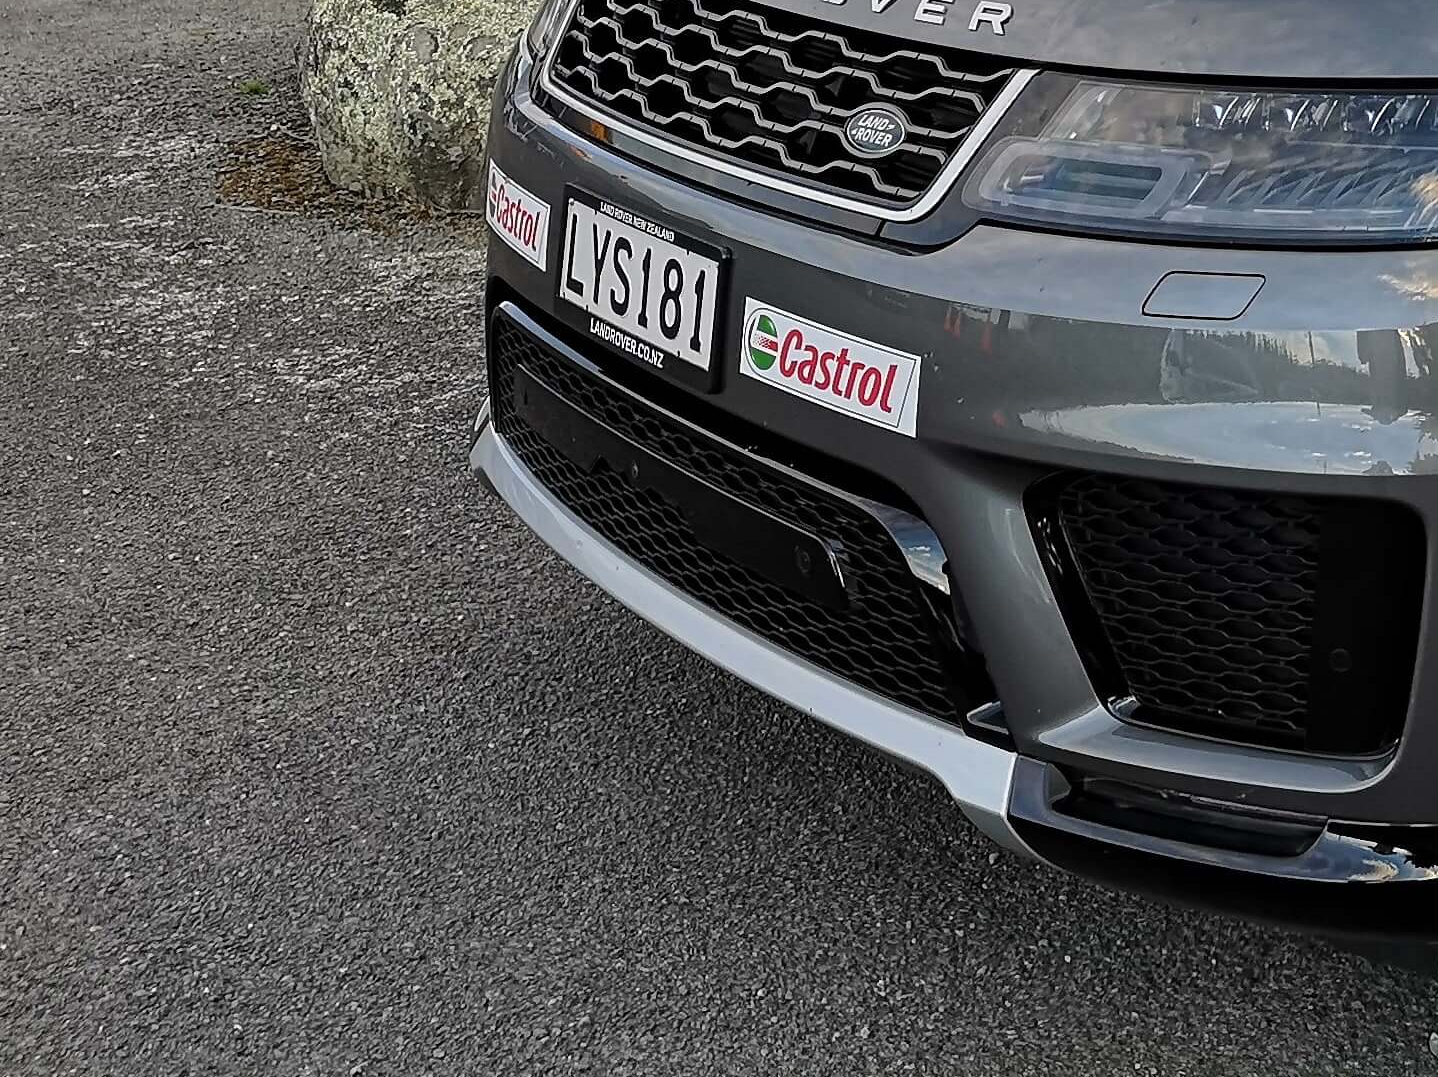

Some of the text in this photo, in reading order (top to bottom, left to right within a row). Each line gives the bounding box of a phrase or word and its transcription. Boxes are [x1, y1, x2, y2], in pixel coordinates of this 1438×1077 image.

[854, 127, 893, 147] ROVER
[857, 114, 890, 131] LAND
[496, 180, 541, 253] Castrol
[600, 201, 675, 243] LAND ROVER NEW ZEALAND
[564, 210, 708, 358] LYS181
[589, 317, 665, 370] LANDROVER.CO.NZ
[778, 327, 898, 415] Castrol
